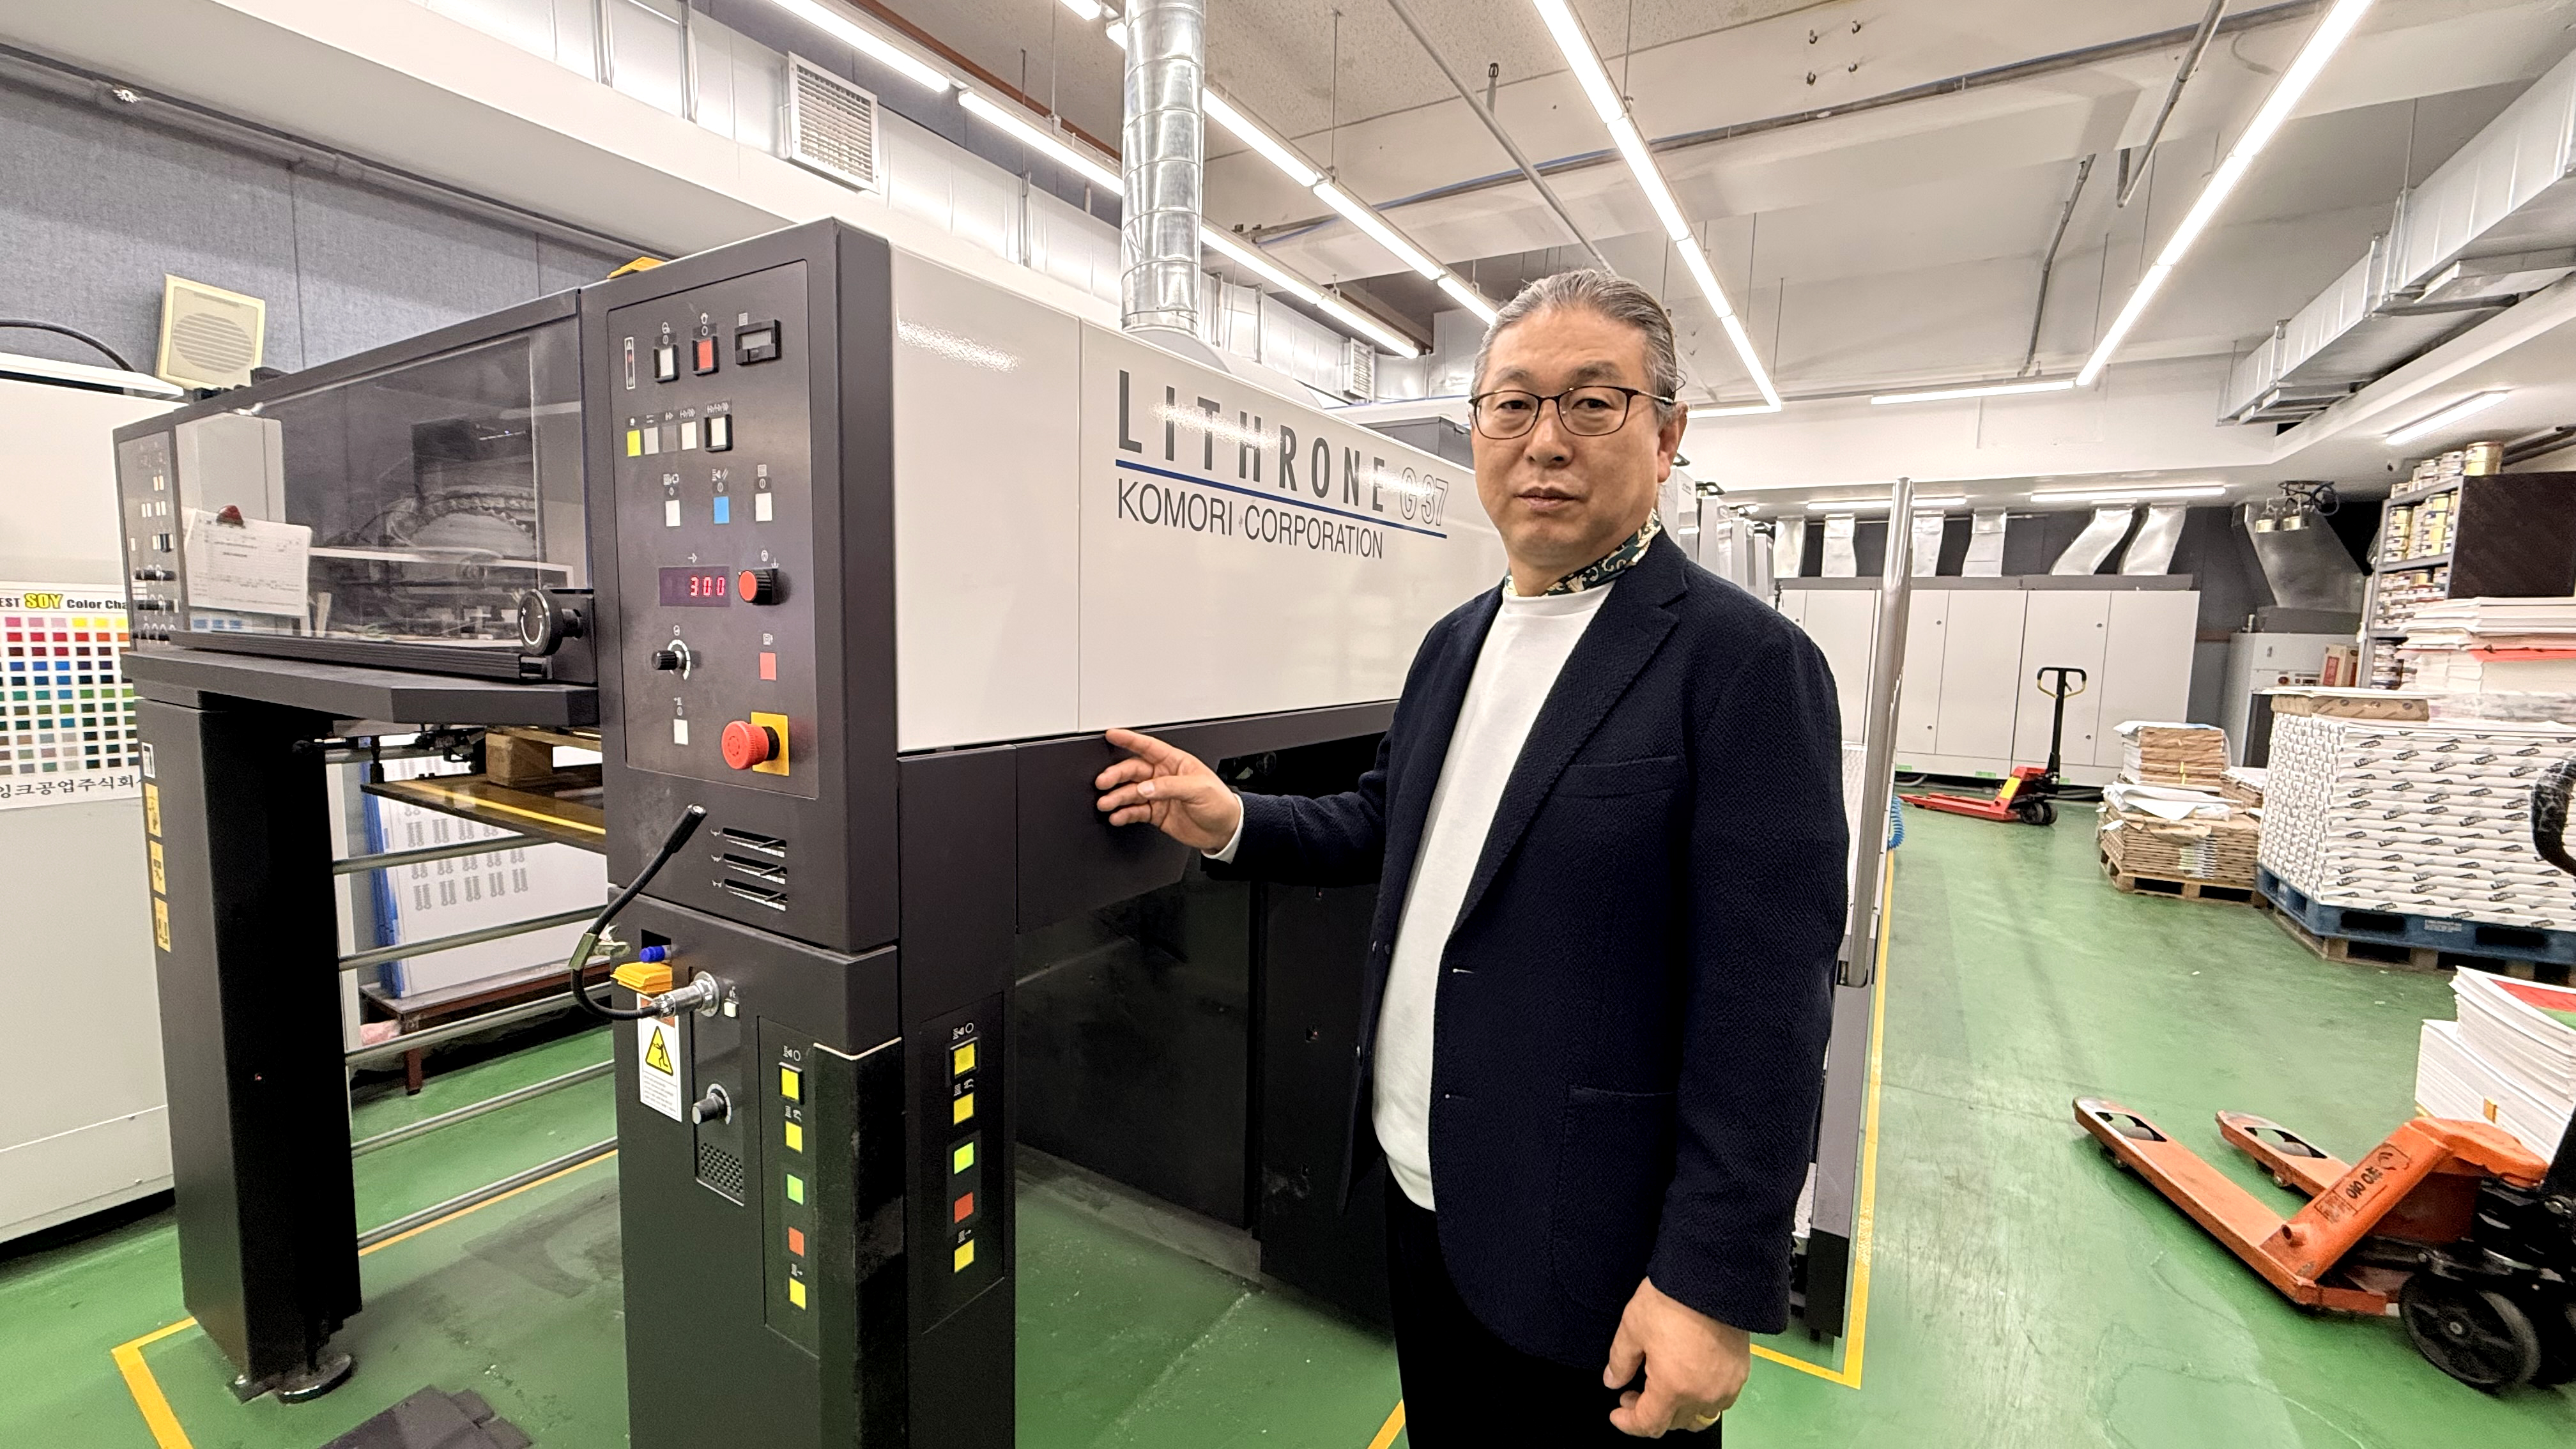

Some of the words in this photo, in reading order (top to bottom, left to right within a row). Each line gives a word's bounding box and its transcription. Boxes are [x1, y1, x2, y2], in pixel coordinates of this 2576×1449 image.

[1119, 369, 1384, 512] LITHRONE
[1118, 478, 1232, 536] KOMORI
[1245, 505, 1383, 559] CORPORATION
[24, 593, 63, 609] SOY
[67, 599, 102, 609] Color
[690, 576, 726, 597] 300
